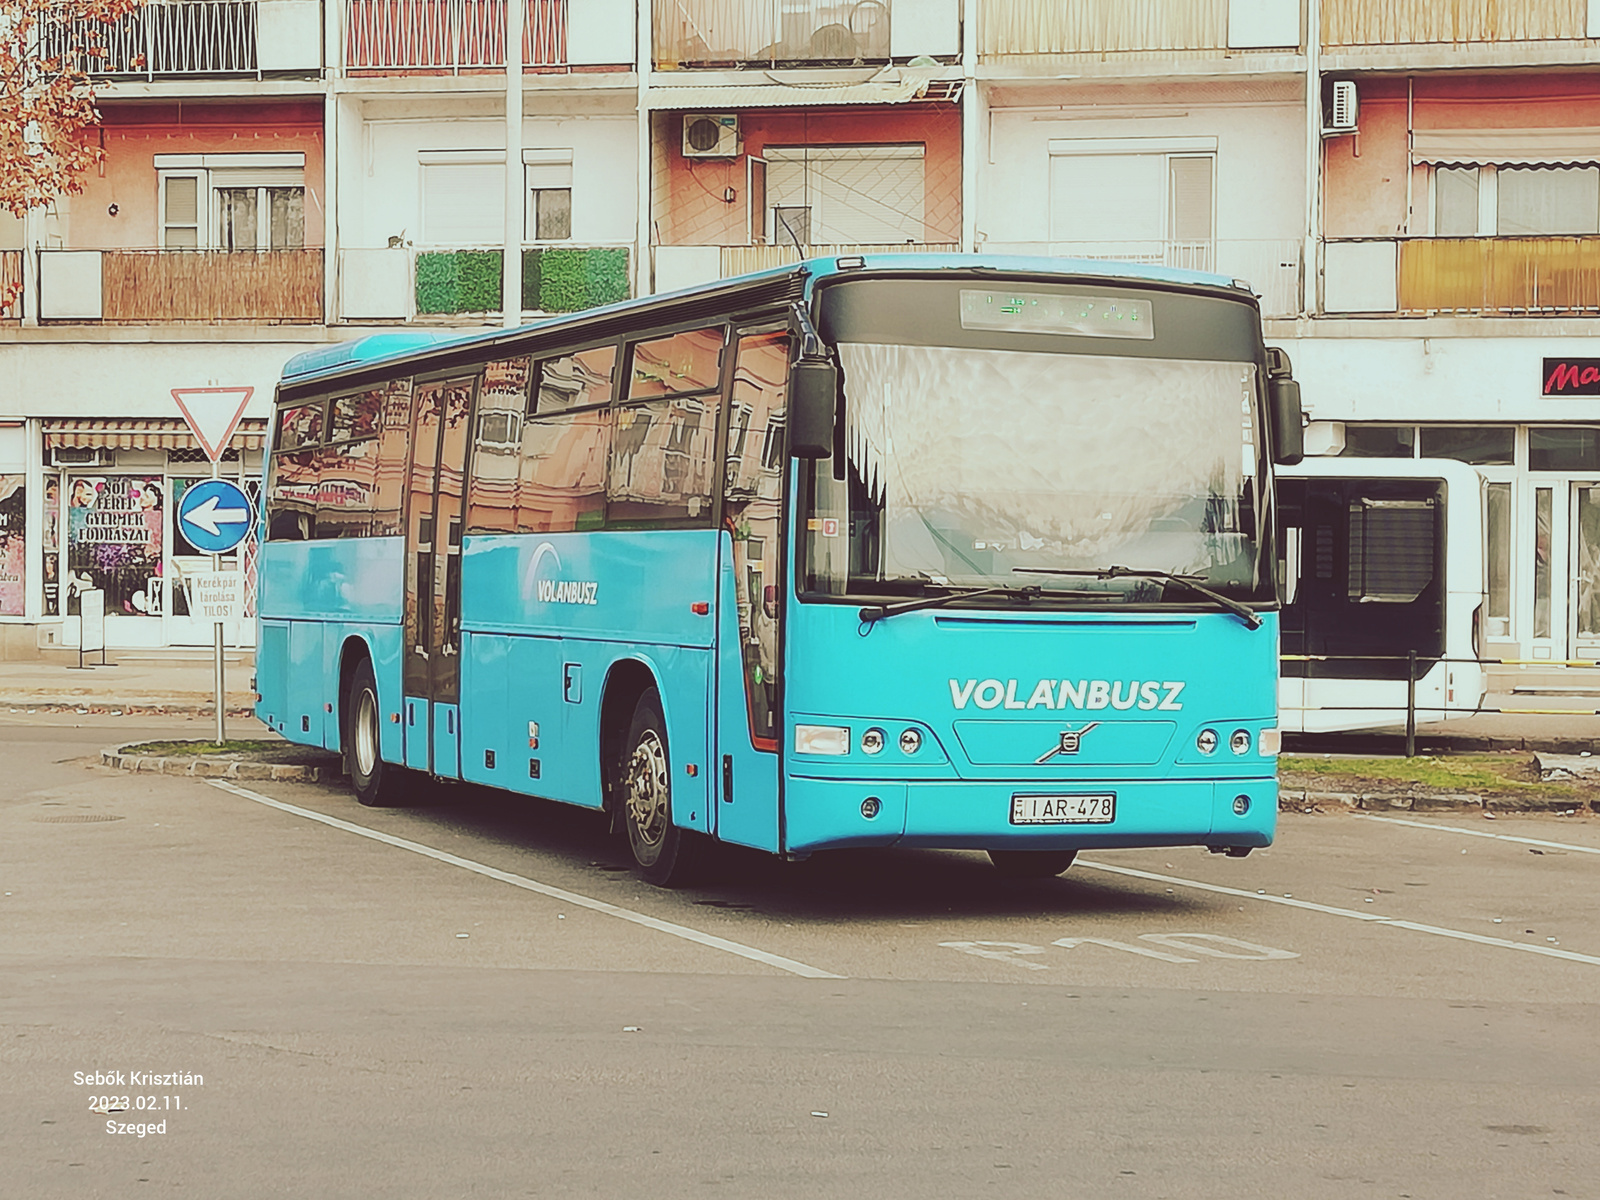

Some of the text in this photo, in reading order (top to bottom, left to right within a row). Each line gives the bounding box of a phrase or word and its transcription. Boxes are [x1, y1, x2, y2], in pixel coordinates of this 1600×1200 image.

[85, 512, 144, 528] GYERMEK
[197, 576, 237, 590] Kerékpár
[203, 604, 233, 617] TILOS!
[949, 679, 1185, 711] VOLÁNBUSZ
[1032, 798, 1112, 817] IAR-478
